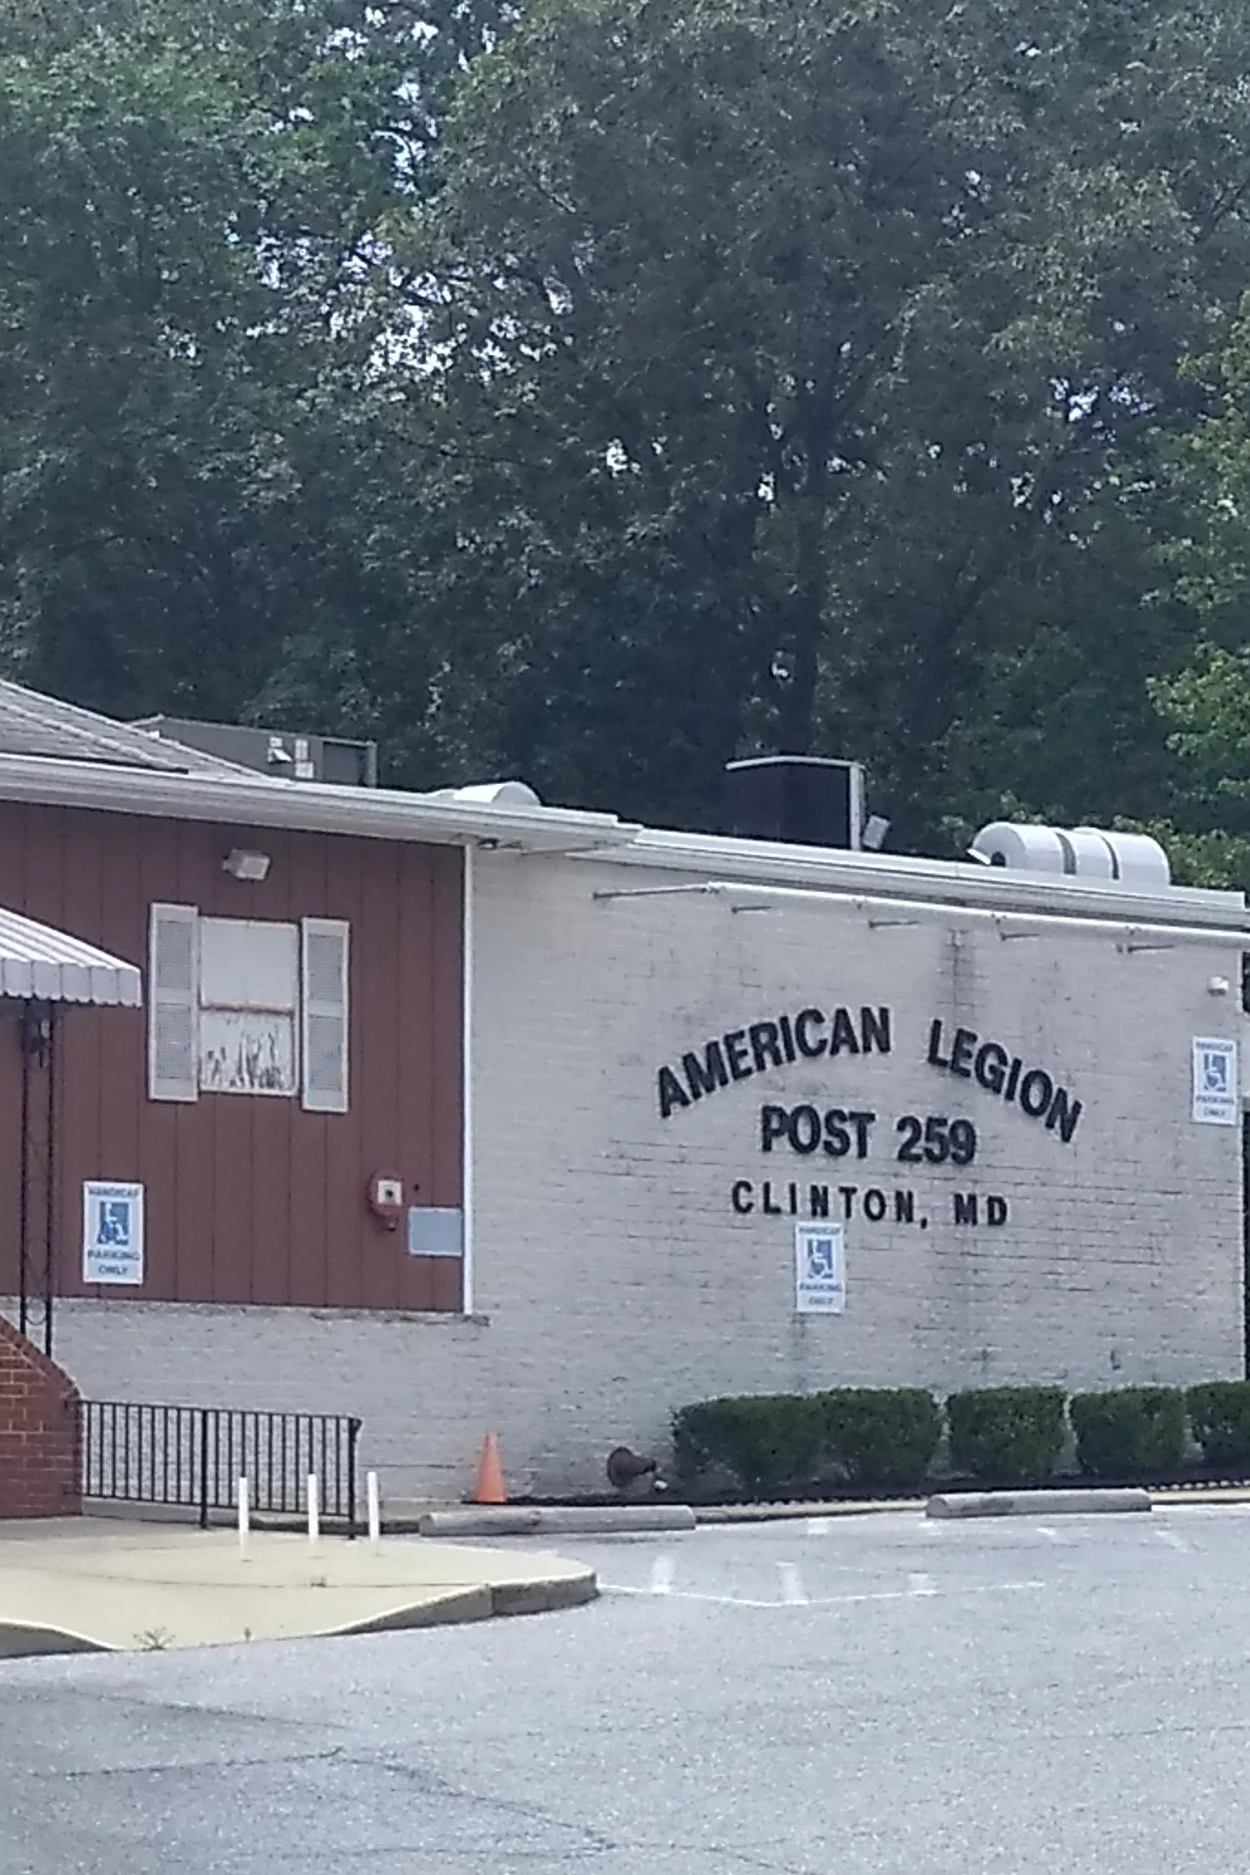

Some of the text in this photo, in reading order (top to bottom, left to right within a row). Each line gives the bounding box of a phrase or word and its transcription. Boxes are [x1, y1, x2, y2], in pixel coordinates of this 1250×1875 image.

[657, 1006, 1082, 1142] AMERICAN LEGION
[761, 1105, 976, 1165] POST 259
[732, 1180, 1008, 1228] CLINTON, MD
